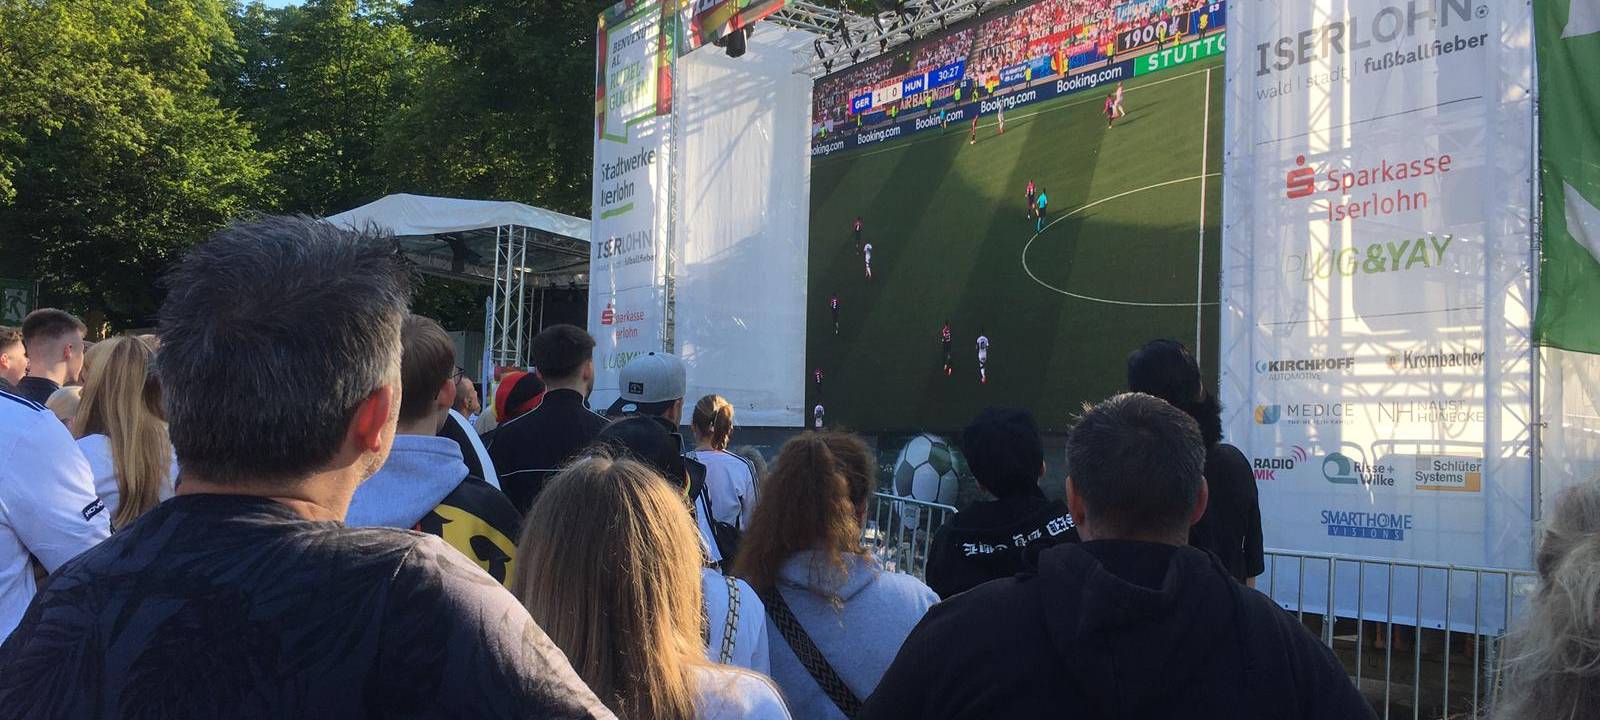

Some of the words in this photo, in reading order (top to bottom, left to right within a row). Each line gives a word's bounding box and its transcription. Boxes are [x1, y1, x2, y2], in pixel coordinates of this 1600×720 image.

[1256, 0, 1472, 77] ISERLOHN
[1256, 79, 1293, 101] wald
[1305, 66, 1347, 89] stadt
[1363, 32, 1489, 74] fußballfieber
[854, 97, 870, 110] GER
[877, 92, 881, 102] 1
[892, 87, 898, 97] 0
[904, 79, 923, 93] HUN
[937, 66, 959, 82] 30:27
[1057, 66, 1122, 93] Booking.com
[980, 89, 1036, 114] Booking.com
[915, 108, 964, 130] Bookin.com
[857, 125, 901, 145] Booking.com
[1327, 154, 1452, 195] Sparkasse
[1328, 189, 1427, 222] Iserlohn
[1286, 235, 1453, 281] PLUG&YAY
[1268, 357, 1355, 372] KIRCHHOFF
[1403, 347, 1485, 369] Krombacher
[1268, 372, 1321, 381] AUTOMOTIVE
[1287, 404, 1355, 416] MEDICE
[1417, 400, 1466, 411] NAUST
[1254, 459, 1294, 470] RADIO
[1354, 462, 1385, 474] Risse
[1433, 460, 1482, 472] Schlüter
[1254, 469, 1275, 480] MK
[1360, 474, 1395, 486] Wilke
[1415, 470, 1464, 484] Systems
[1333, 527, 1401, 540] VISIONS
